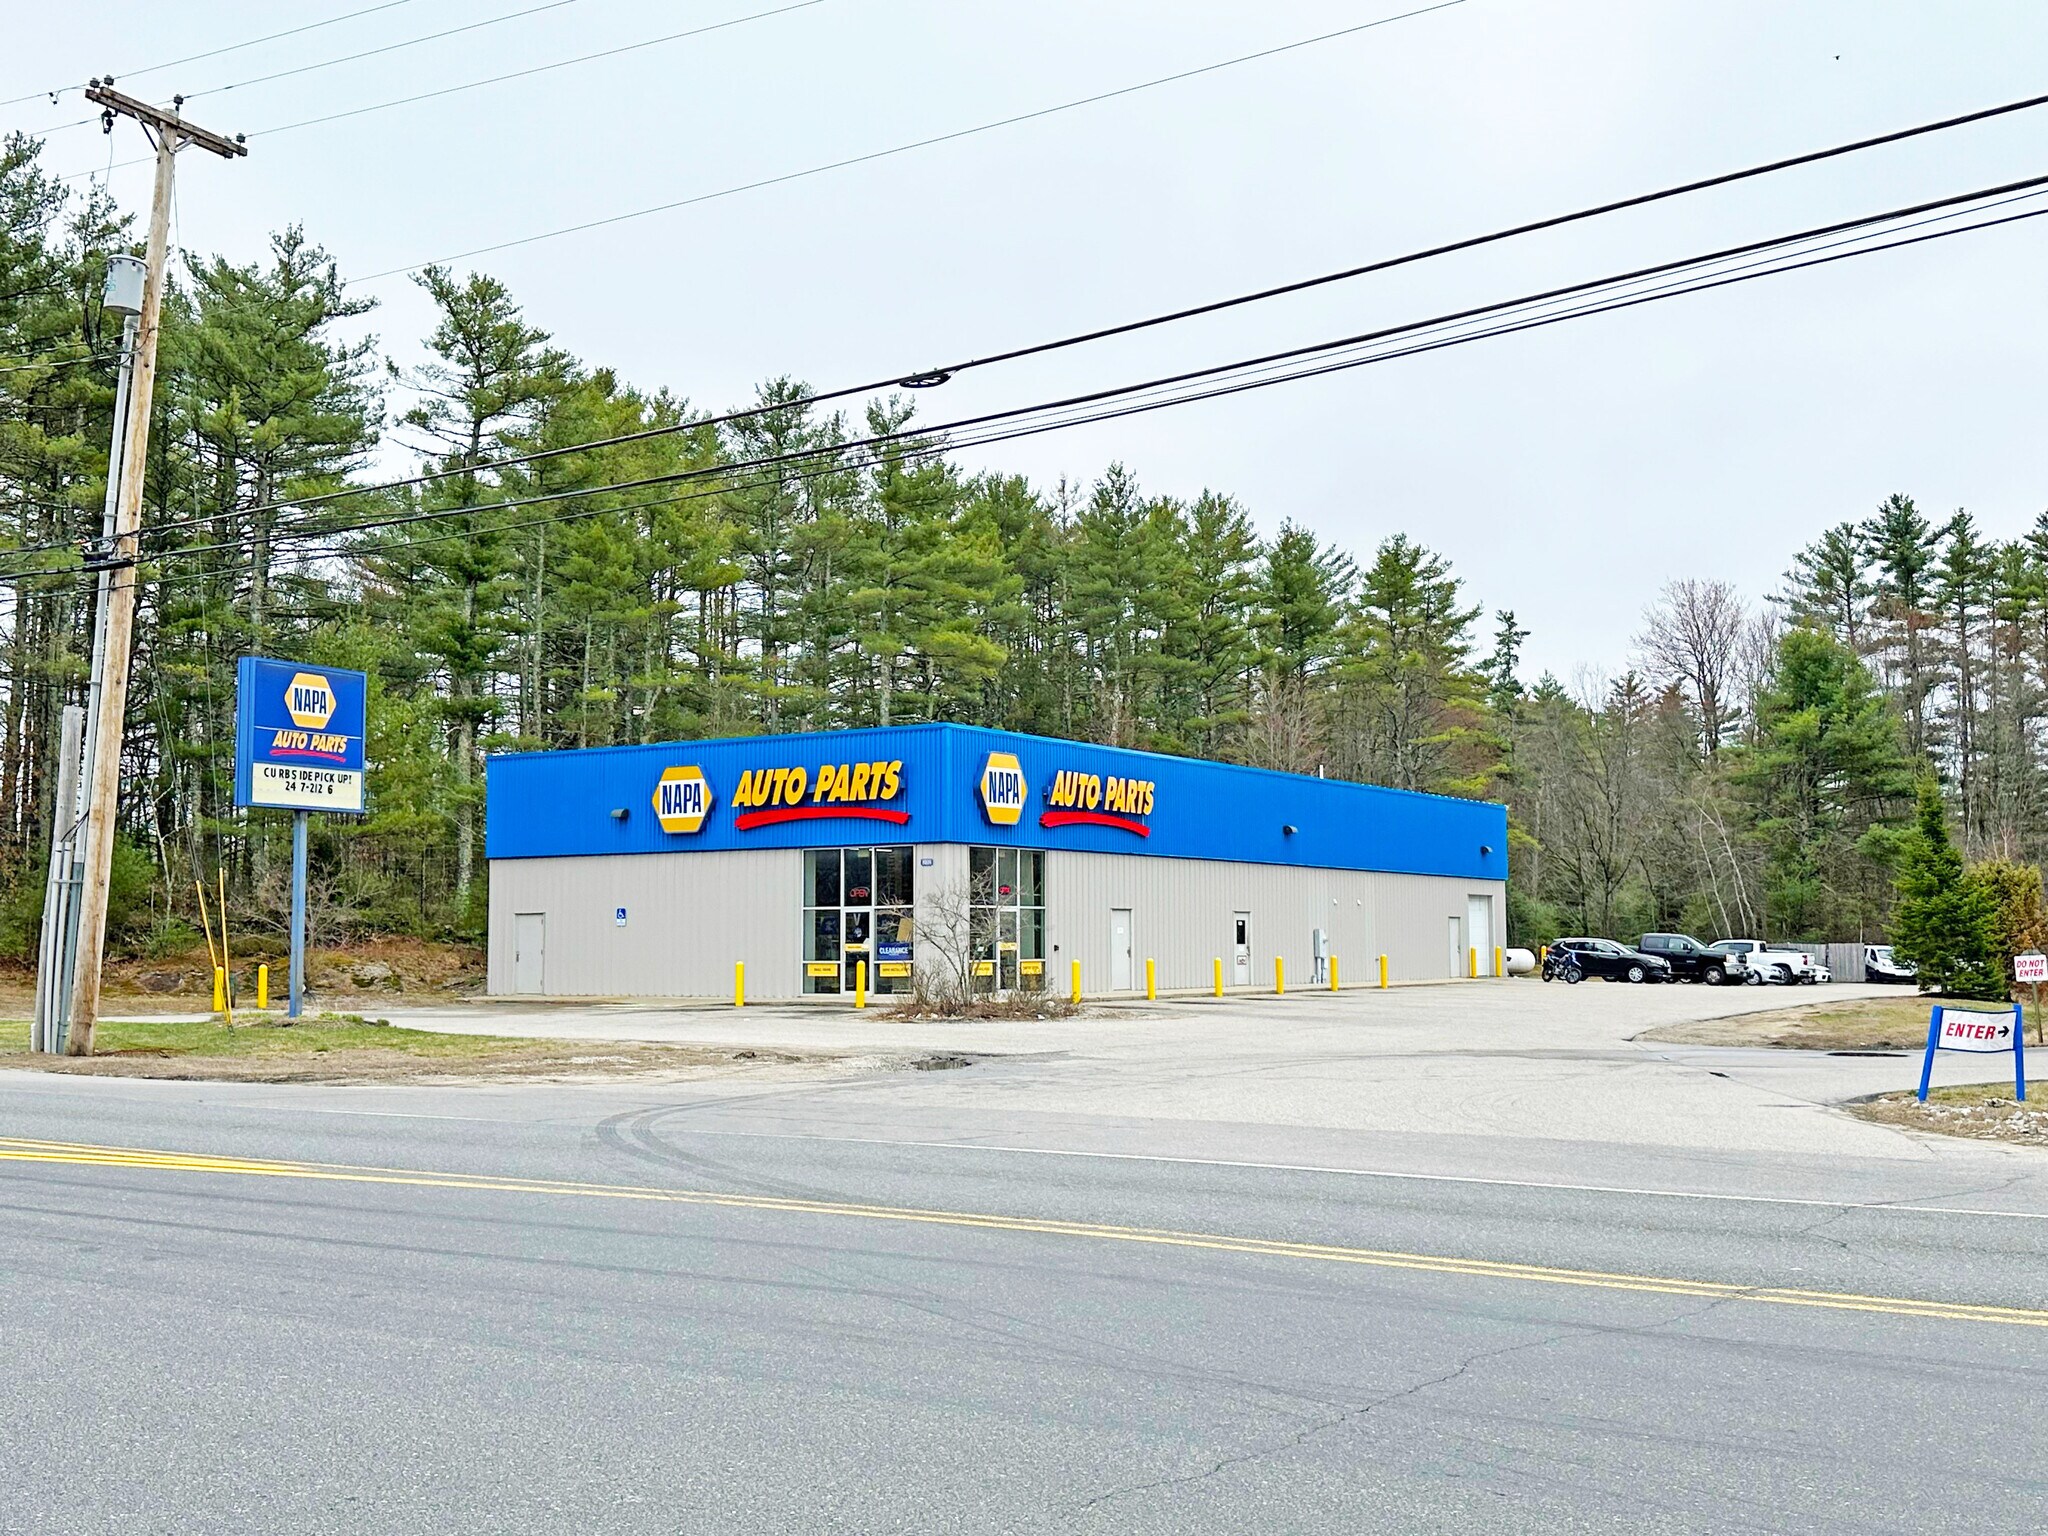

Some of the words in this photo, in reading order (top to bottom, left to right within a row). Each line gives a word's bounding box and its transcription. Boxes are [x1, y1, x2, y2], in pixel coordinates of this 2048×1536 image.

[293, 687, 327, 714] NAPA
[272, 730, 308, 750] AUTO
[309, 734, 348, 754] PARTS
[314, 771, 335, 783] PICK
[731, 766, 808, 808] AUTO
[813, 760, 903, 803] PARTS
[988, 771, 1020, 805] NAPA
[662, 782, 702, 815] NAPA
[1050, 769, 1102, 810] AUTO
[1104, 776, 1155, 816] PARTS
[878, 946, 909, 955] CLEARANCE
[2016, 960, 2027, 968] DO
[2028, 959, 2045, 968] NOT
[2018, 968, 2044, 977] ENTER
[1946, 1022, 1996, 1040] ENTER
